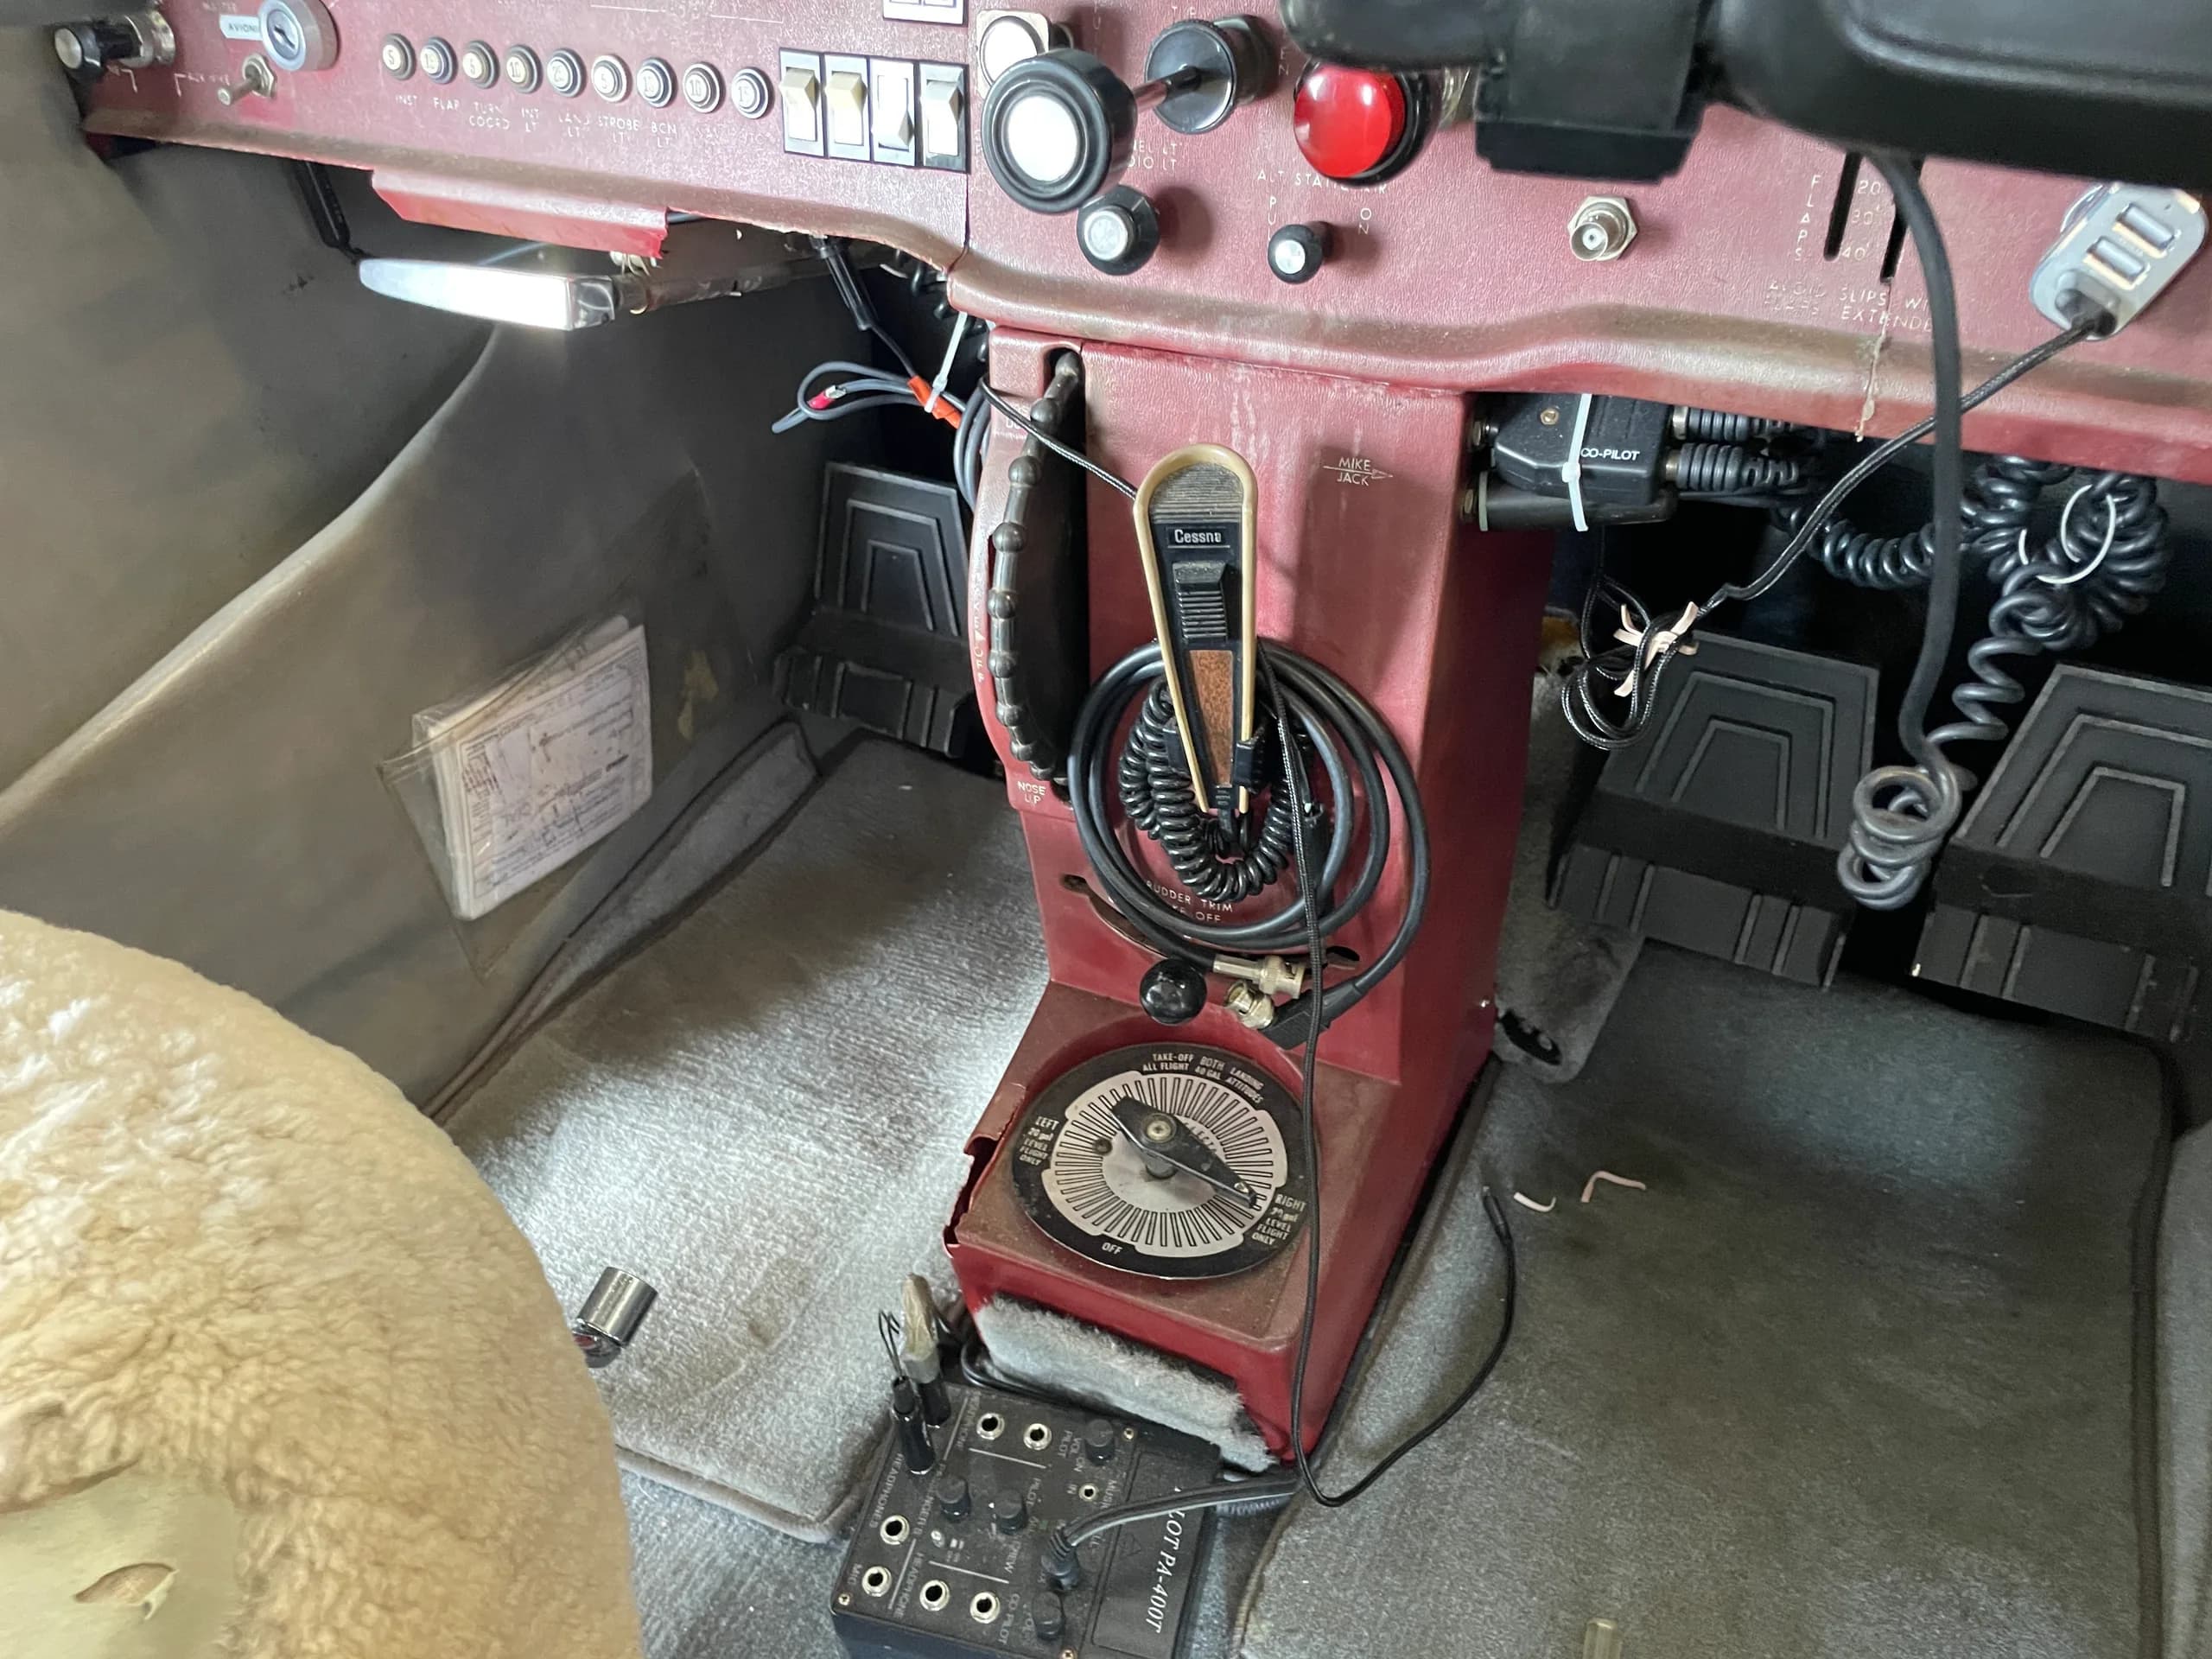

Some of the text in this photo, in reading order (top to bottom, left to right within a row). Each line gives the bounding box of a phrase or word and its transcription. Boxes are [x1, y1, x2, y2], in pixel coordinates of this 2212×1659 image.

[433, 97, 461, 111] FLAP
[598, 115, 639, 131] STROBE
[651, 121, 677, 135] BCN
[1257, 168, 1285, 183] ALT
[1357, 207, 1372, 235] ON
[1795, 175, 1821, 260] FLAPS
[1840, 285, 1887, 306] SLIPS
[1841, 305, 1933, 333] EXTENDE
[1580, 448, 1640, 461] CO-PILOT
[1338, 456, 1371, 471] MIKE
[1337, 472, 1370, 486] JACK
[1174, 529, 1222, 543] Cessna
[1018, 781, 1046, 796] NOSE
[1025, 794, 1040, 805] UP
[1146, 880, 1192, 906] RUDDER
[1201, 899, 1233, 912] TRIM
[1195, 912, 1221, 923] OFF
[1152, 1052, 1194, 1064] TAKE-OFF
[1199, 1055, 1225, 1071] BOTH
[1142, 1062, 1158, 1072] ALL
[1160, 1062, 1190, 1071] FLIGHT
[1224, 1076, 1265, 1104] ATTITUDES
[1035, 1116, 1060, 1131] LEFT
[1023, 1138, 1048, 1151] LEVEL
[1019, 1154, 1042, 1166] ONLY
[1020, 1146, 1049, 1160] FLIGHT
[1274, 1193, 1307, 1212] RIGHT
[1256, 1224, 1289, 1241] FLIGHT
[1265, 1217, 1292, 1233] LEVEL
[1251, 1231, 1276, 1245] ONLY
[1101, 1242, 1123, 1255] OFF
[869, 1452, 905, 1529] HEADPHONES
[1146, 1550, 1177, 1634] PA-400T
